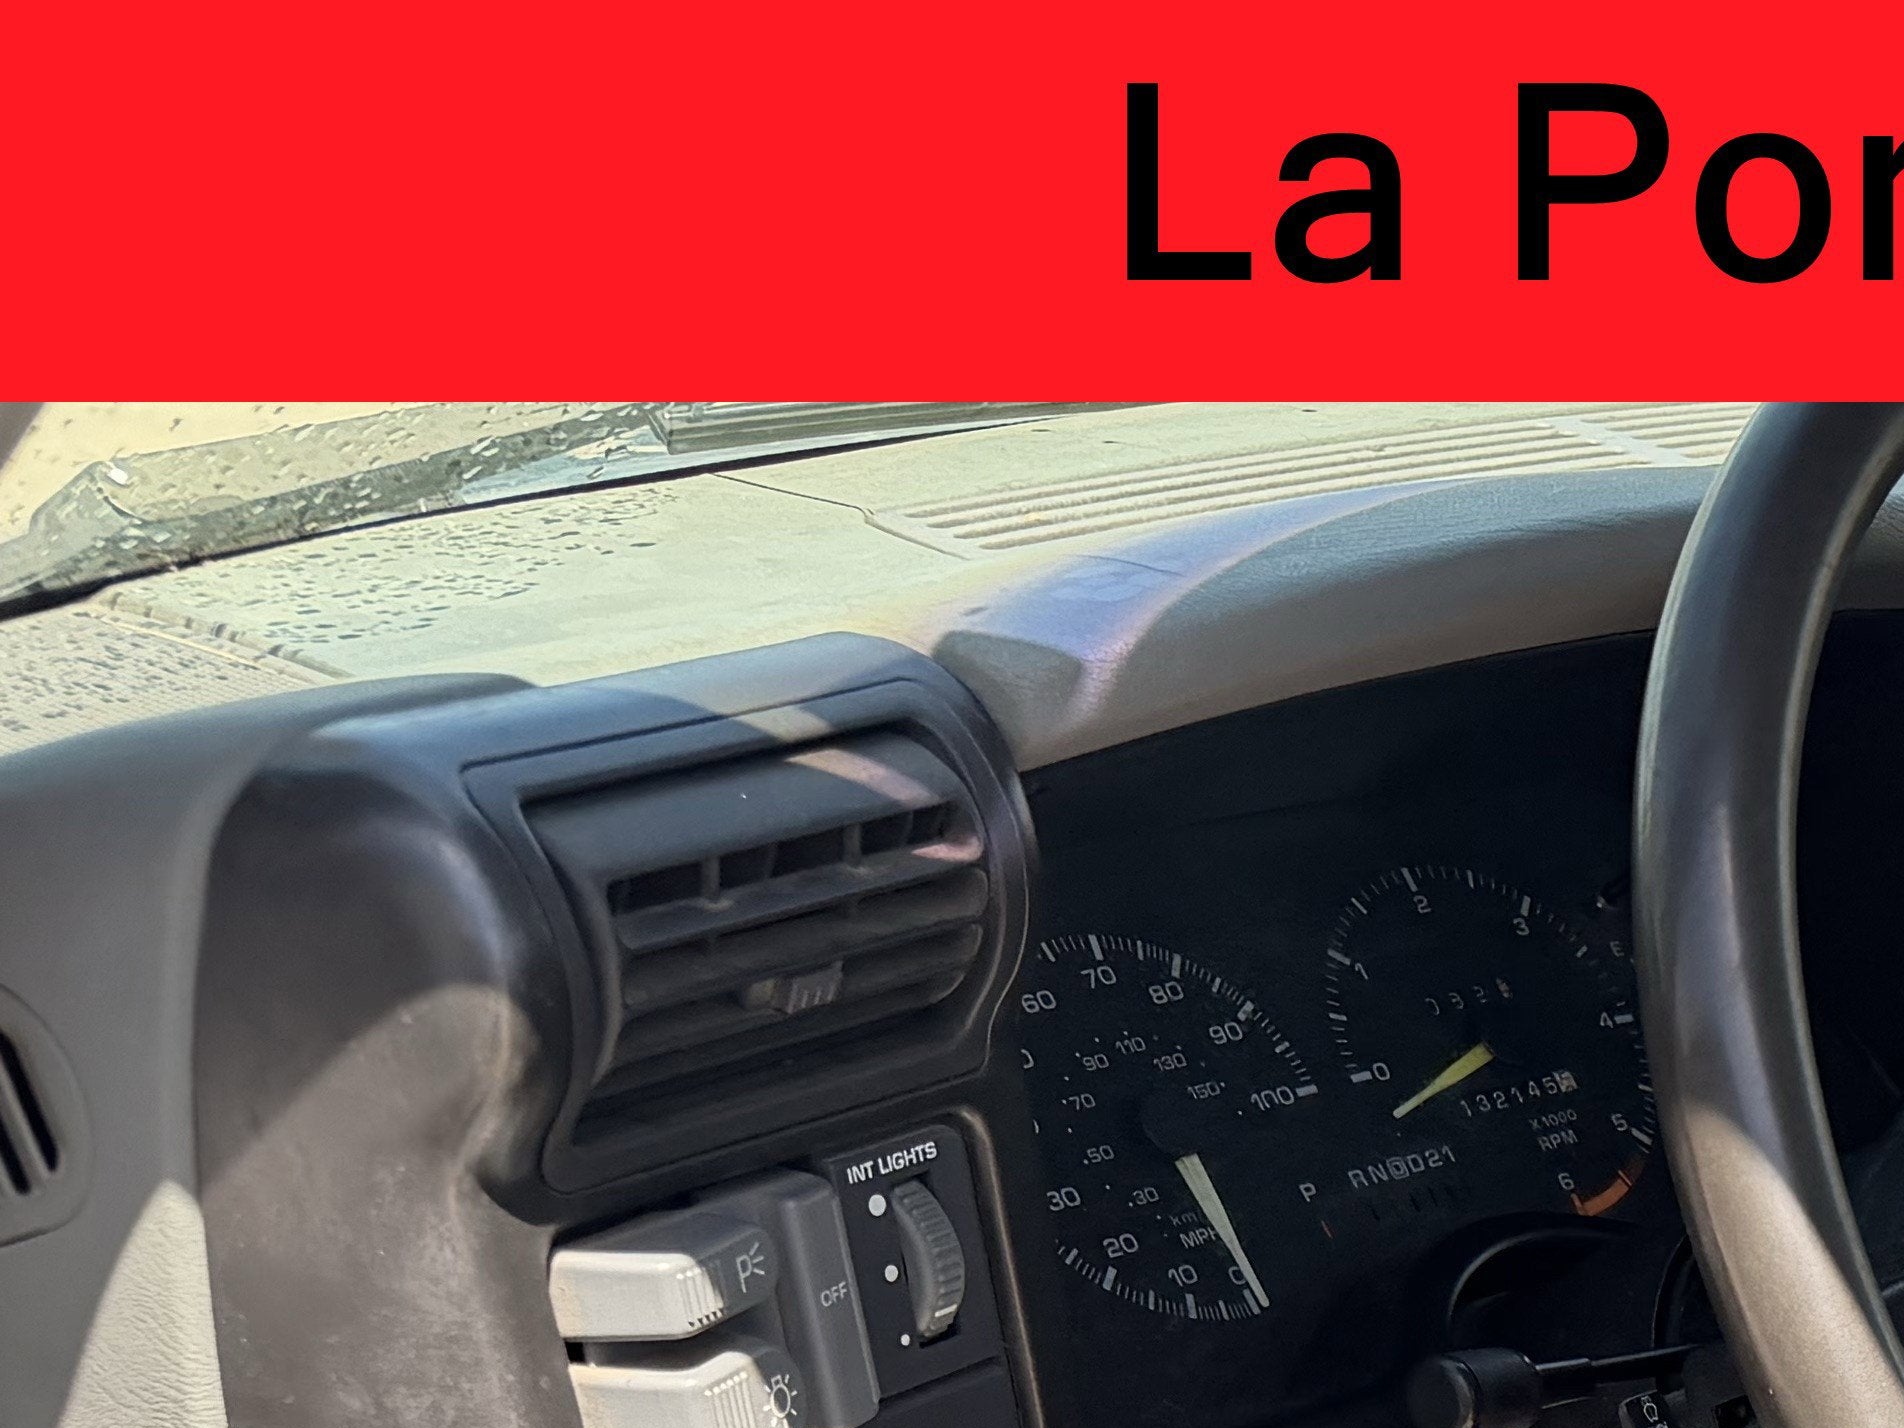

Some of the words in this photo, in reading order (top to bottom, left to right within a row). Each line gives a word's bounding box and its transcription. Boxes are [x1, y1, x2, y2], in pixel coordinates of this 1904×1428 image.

[1413, 896, 1431, 913] 2
[1513, 917, 1530, 935] 3
[1081, 965, 1117, 989] 70
[1355, 963, 1369, 980] 1
[1021, 990, 1057, 1013] 60
[1149, 981, 1184, 1005] 80
[1600, 1012, 1614, 1029] 4
[1209, 1021, 1243, 1045] 90
[1116, 1036, 1146, 1055] 110
[1083, 1053, 1109, 1071] 90
[1153, 1053, 1187, 1072] 130
[1187, 1081, 1221, 1099] 150
[1250, 1085, 1295, 1111] 100
[1069, 1093, 1096, 1110] 70
[1611, 1113, 1628, 1132] 5
[1537, 1129, 1578, 1151] RPM
[847, 1163, 875, 1185] INT
[878, 1141, 938, 1175] LIGHTS
[1087, 1145, 1115, 1163] 50
[1558, 1172, 1575, 1190] 6
[1047, 1187, 1081, 1211] 30
[1133, 1187, 1160, 1205] 30
[1103, 1233, 1139, 1258] 20
[1168, 1265, 1199, 1287] 10
[820, 1282, 848, 1307] OFF
